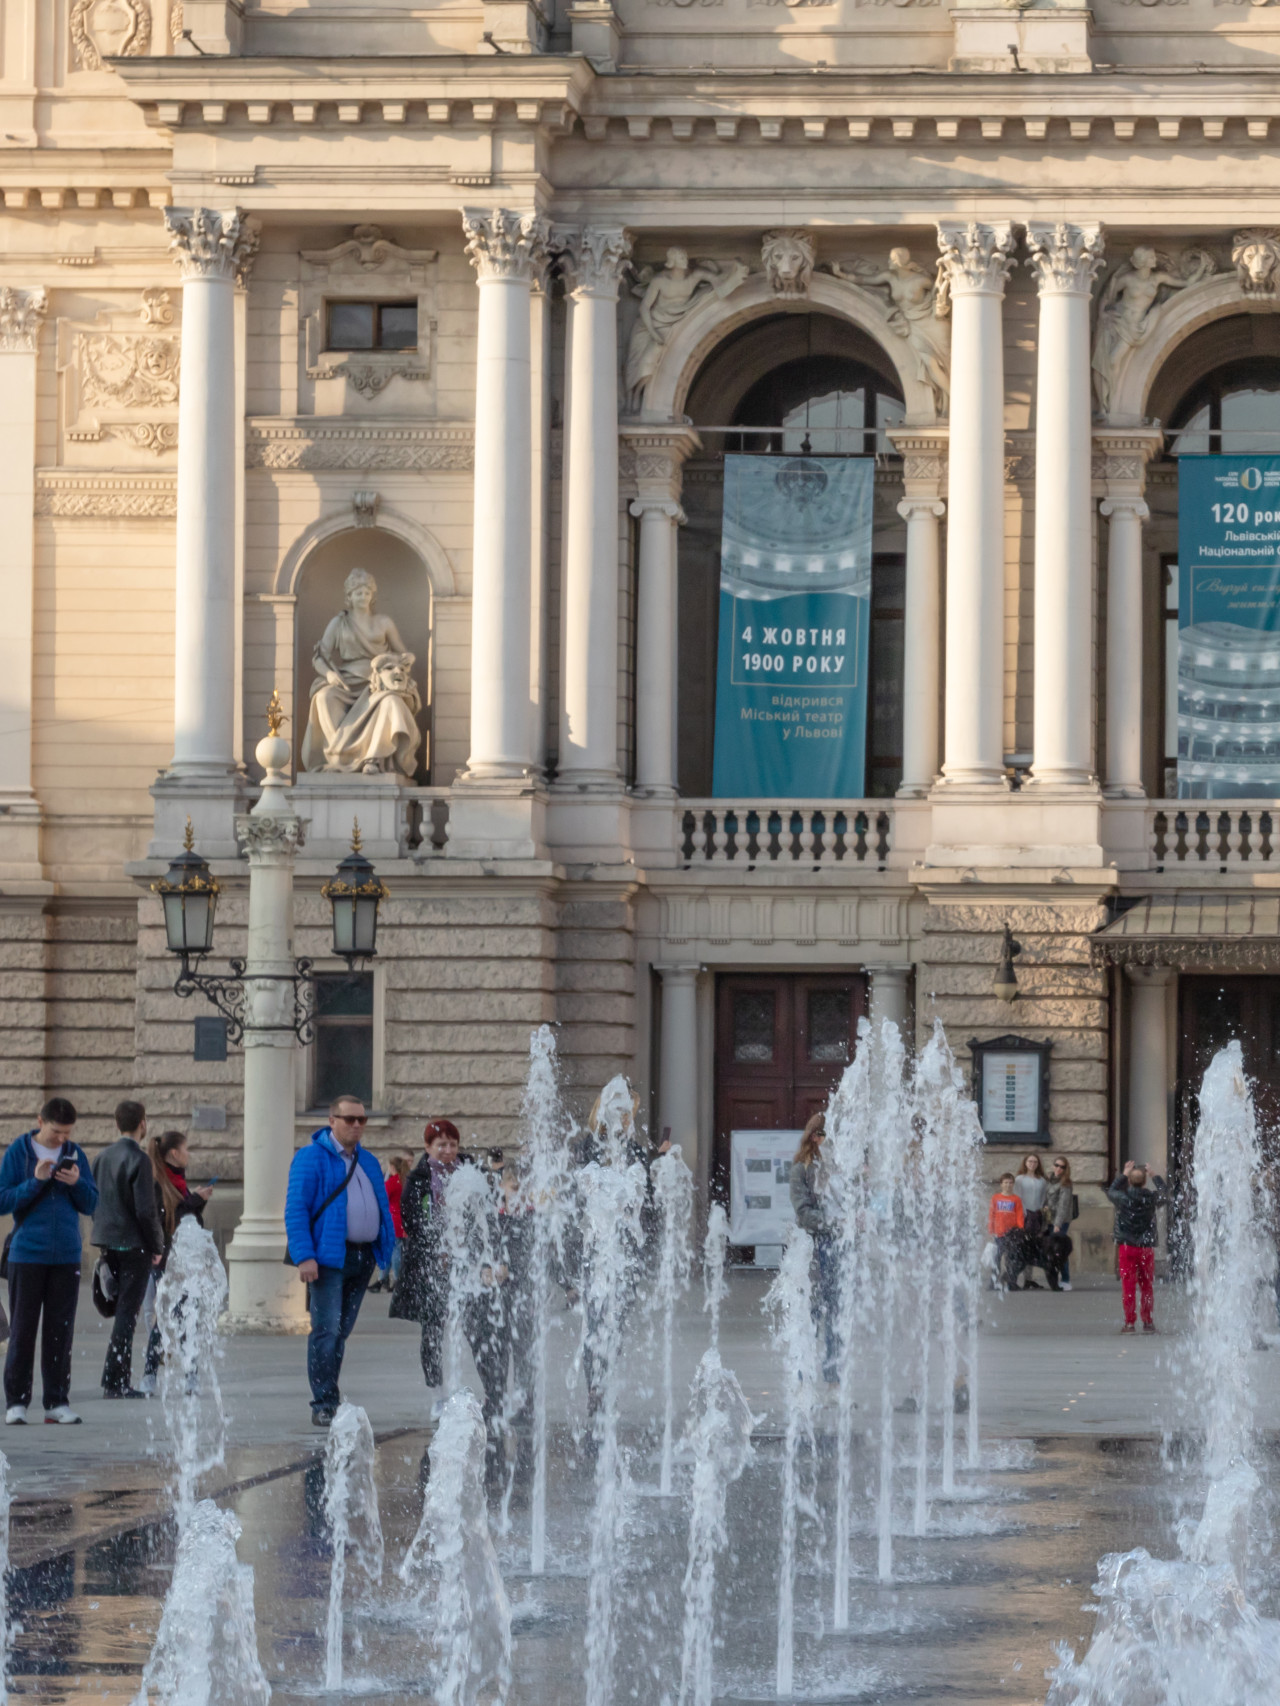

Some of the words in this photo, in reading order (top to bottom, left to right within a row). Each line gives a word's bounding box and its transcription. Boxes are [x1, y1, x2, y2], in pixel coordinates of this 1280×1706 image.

[1211, 503, 1249, 523] 120
[1199, 545, 1275, 558] Національній
[741, 626, 752, 643] 4
[762, 626, 846, 646] ЖОВТНЯ
[742, 653, 784, 672] 1900
[792, 655, 845, 673] РОКУ
[771, 694, 844, 708] відкрився
[740, 707, 800, 722] Міський
[805, 711, 843, 724] театр
[783, 728, 791, 740] у
[795, 725, 843, 738] Львові
